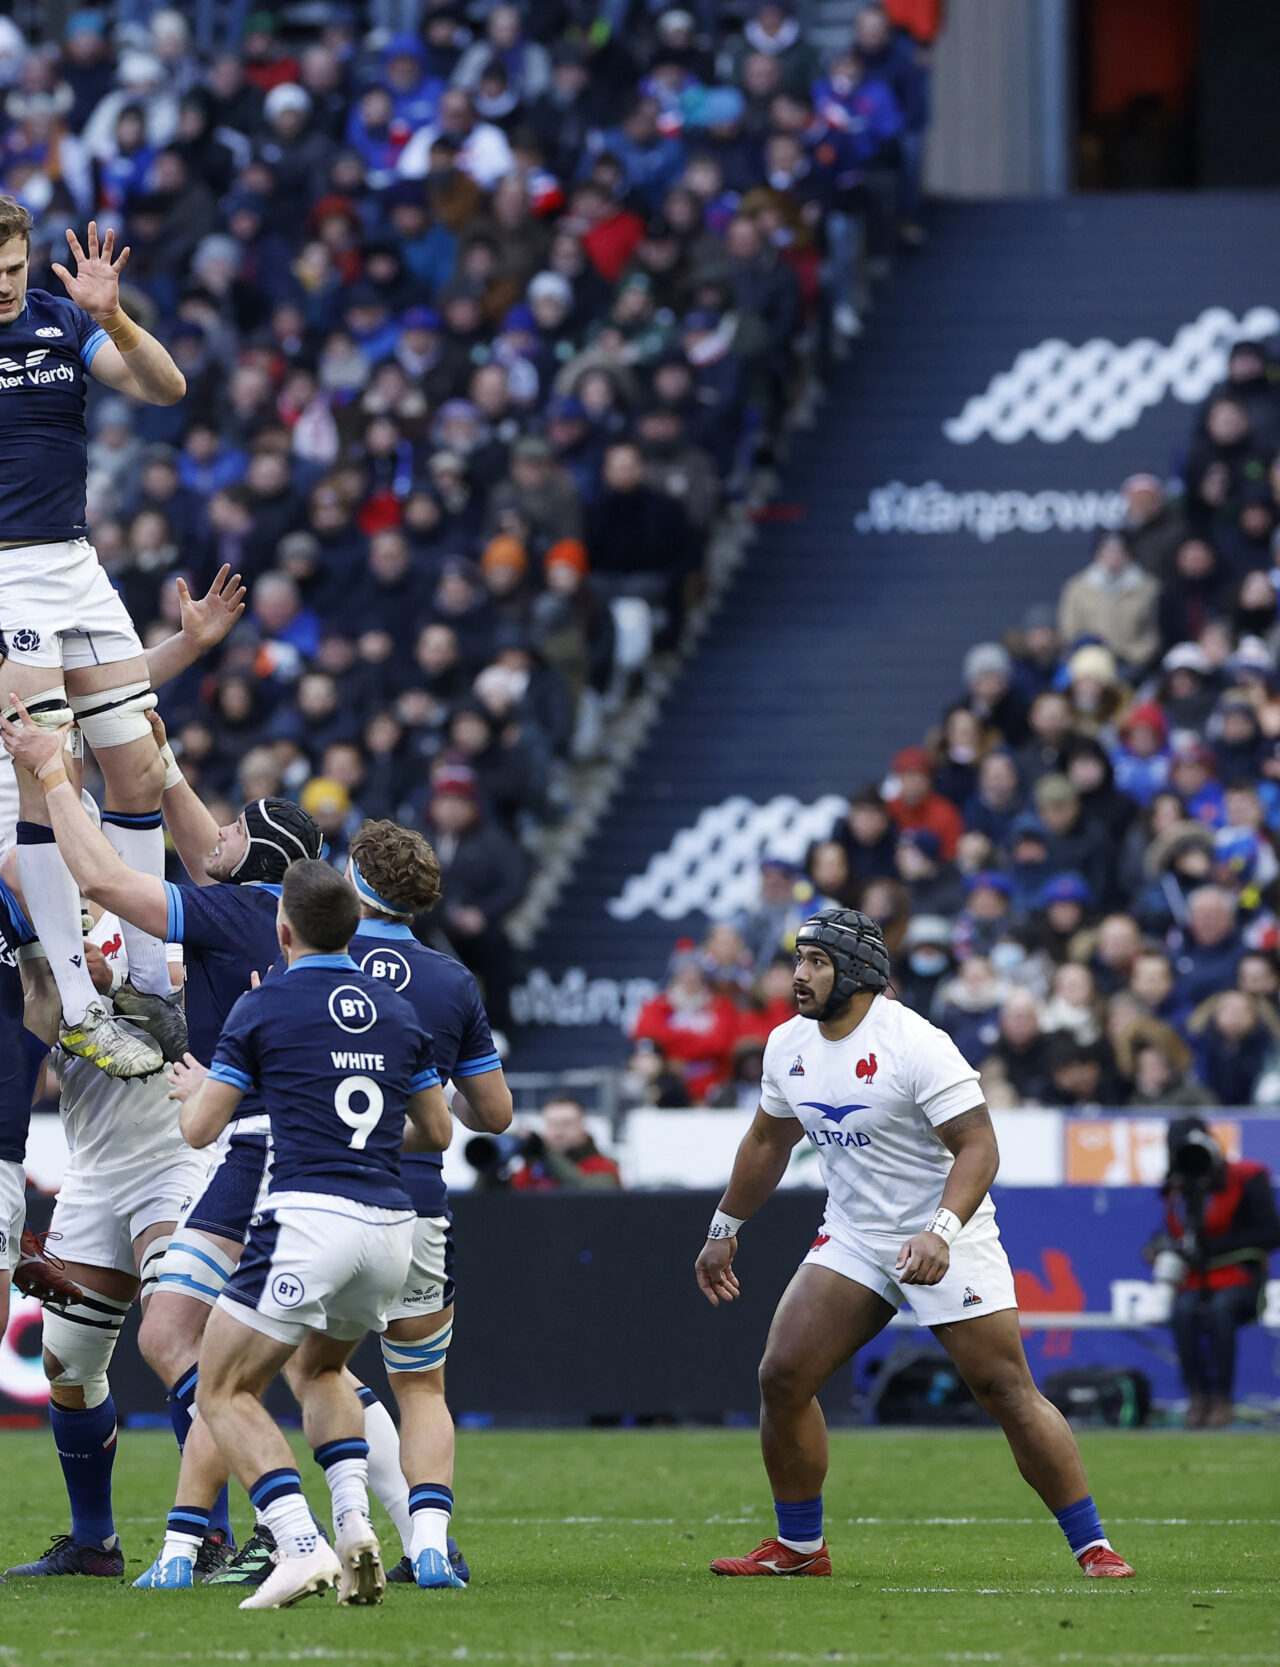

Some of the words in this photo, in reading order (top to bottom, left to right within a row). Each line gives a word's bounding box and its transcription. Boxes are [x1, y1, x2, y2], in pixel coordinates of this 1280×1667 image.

[27, 364, 74, 383] Vardy
[372, 960, 400, 980] BT
[339, 998, 366, 1018] BT
[330, 1051, 385, 1071] WHITE
[334, 1075, 384, 1150] 9
[278, 1281, 299, 1298] BT
[423, 1291, 440, 1301] Vardy
